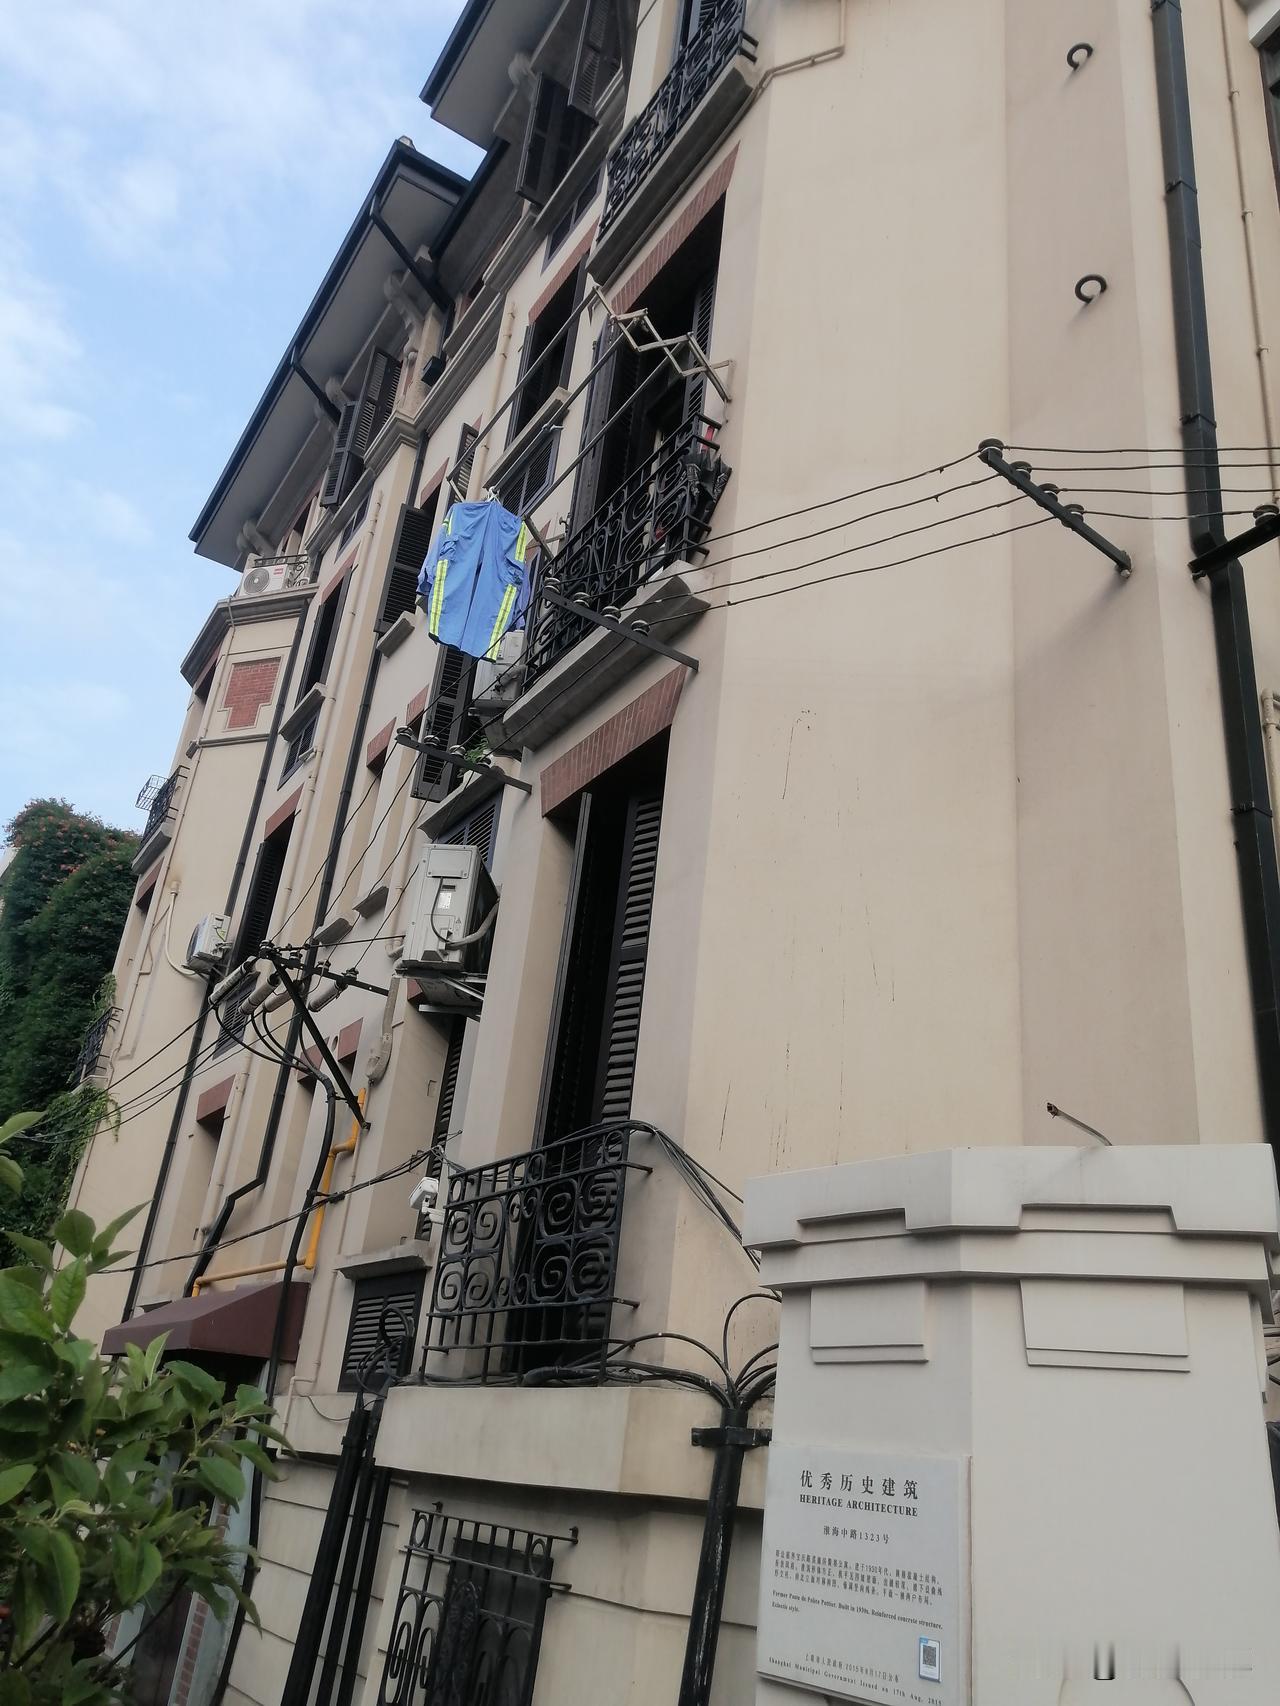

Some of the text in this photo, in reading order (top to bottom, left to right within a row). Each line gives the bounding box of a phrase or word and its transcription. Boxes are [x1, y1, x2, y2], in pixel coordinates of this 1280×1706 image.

[800, 1469, 918, 1500] 优秀历史建筑
[800, 1494, 918, 1517] HERITAGE ARCHITECTURE
[823, 1525, 890, 1545] 淮海中路1323号
